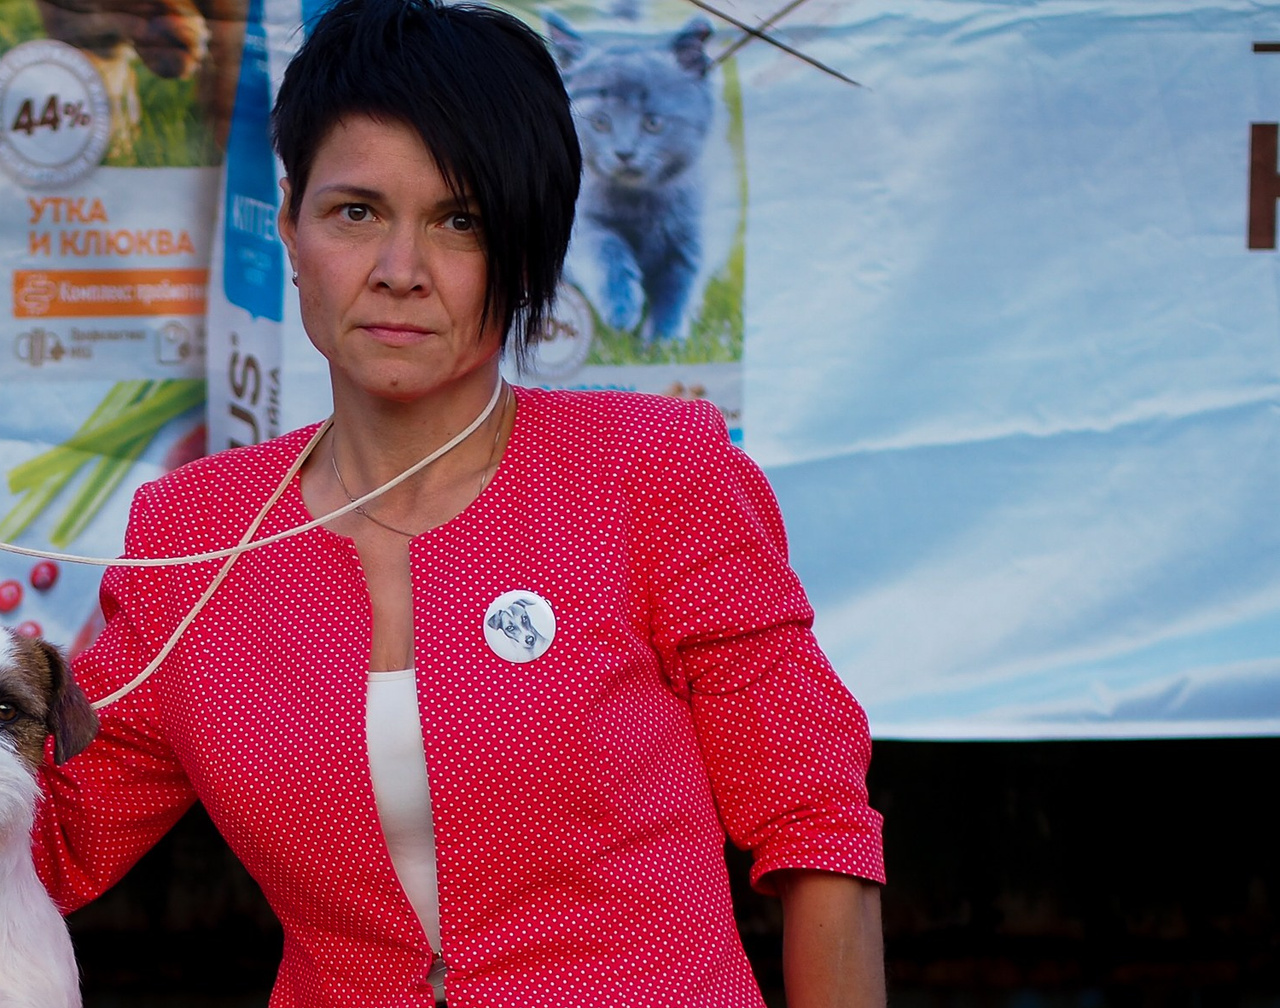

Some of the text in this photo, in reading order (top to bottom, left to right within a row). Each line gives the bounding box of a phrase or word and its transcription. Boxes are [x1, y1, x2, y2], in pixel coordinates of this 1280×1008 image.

[12, 95, 92, 135] 44%
[28, 197, 108, 225] УТКА
[28, 230, 196, 256] И КЛЮКВА
